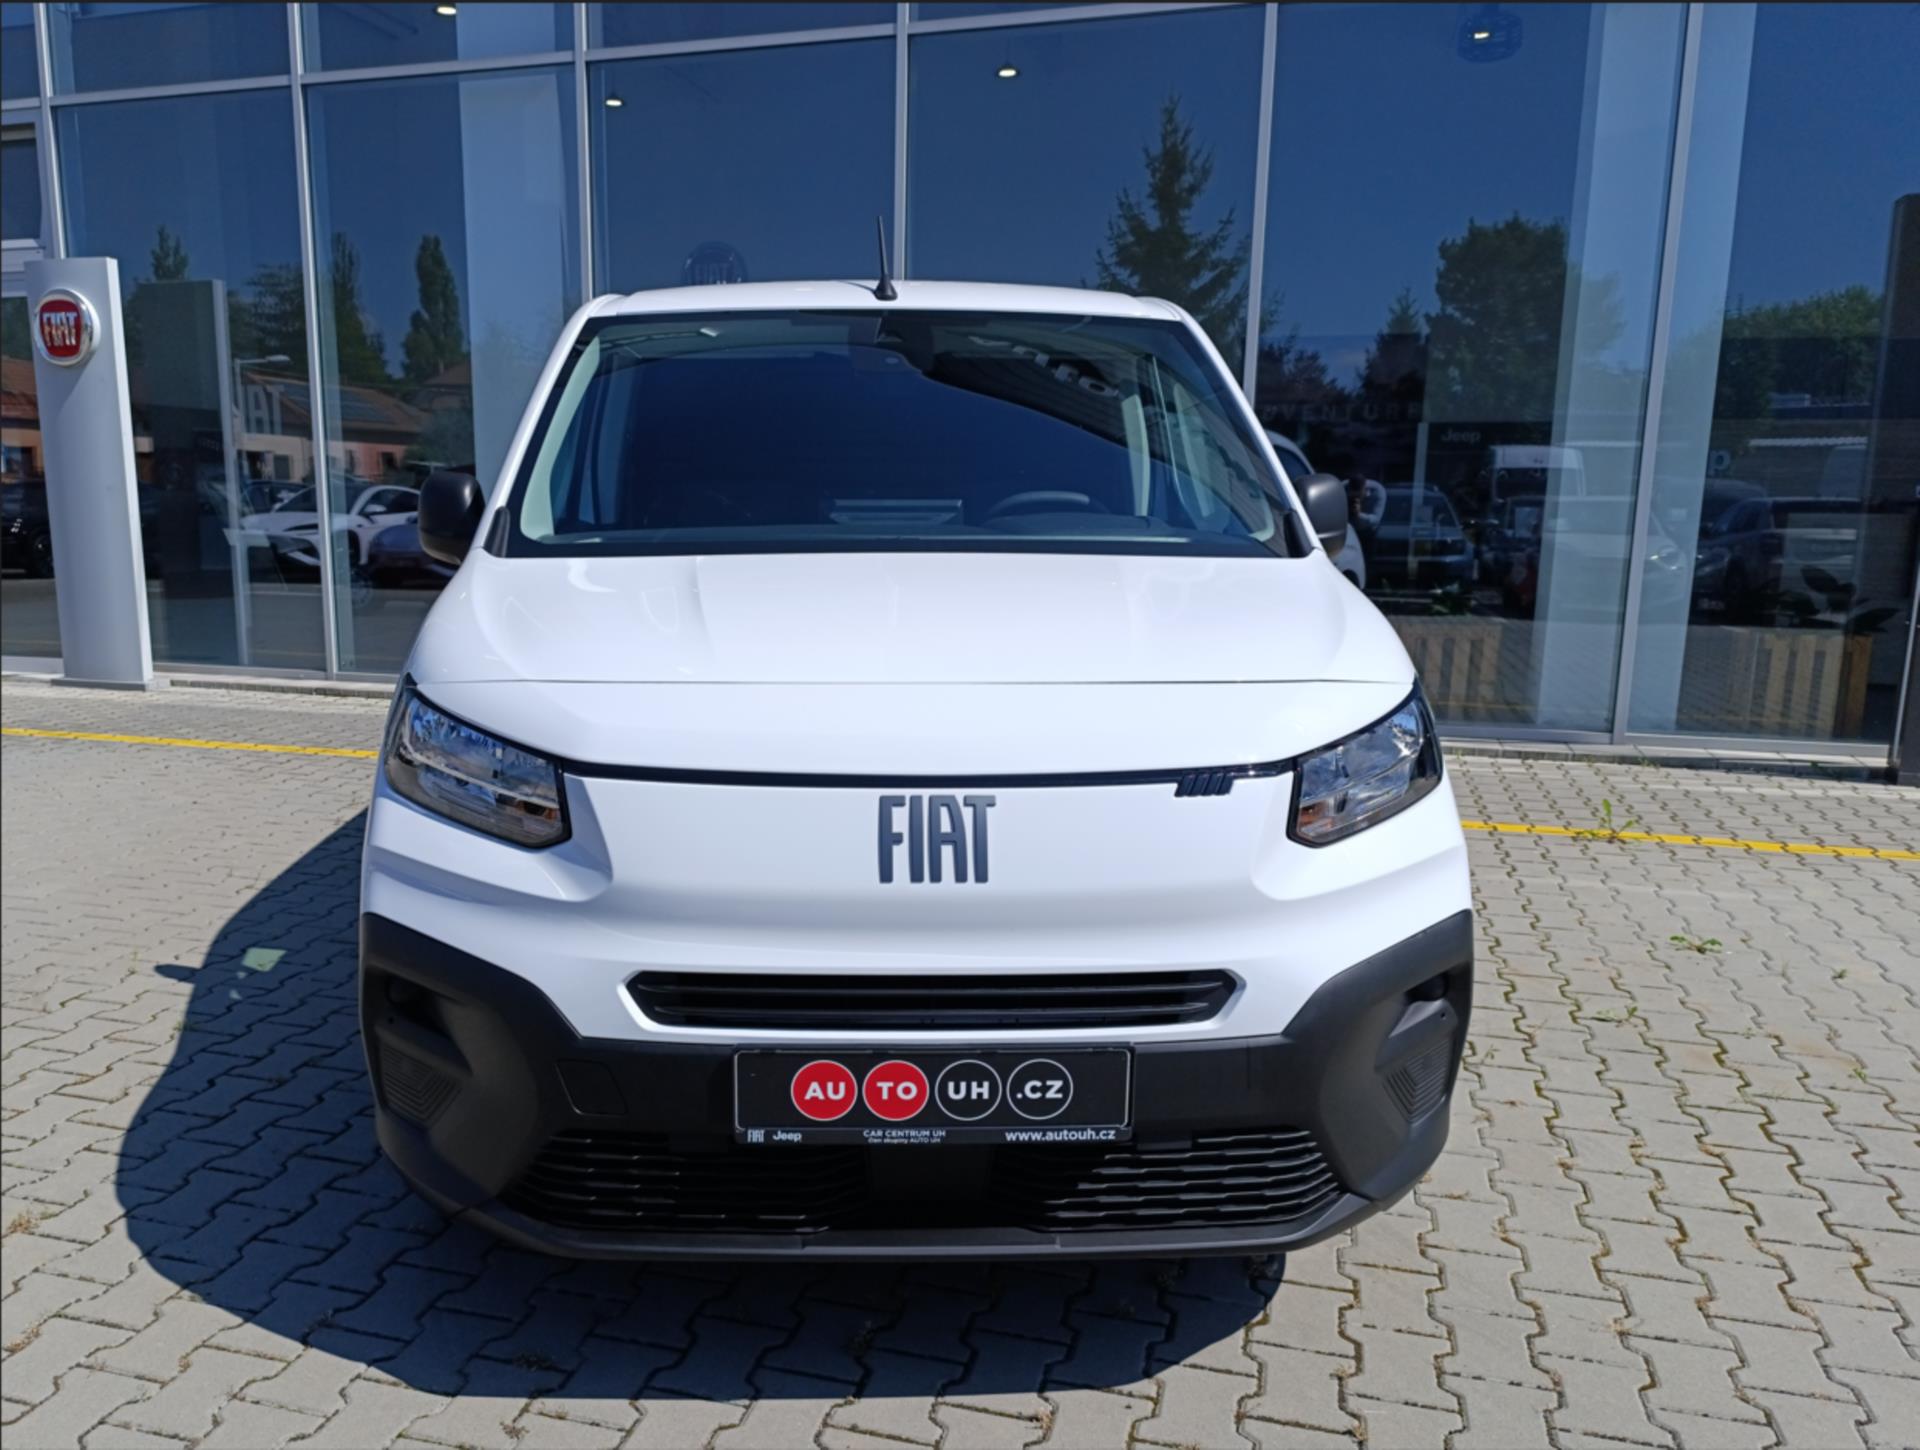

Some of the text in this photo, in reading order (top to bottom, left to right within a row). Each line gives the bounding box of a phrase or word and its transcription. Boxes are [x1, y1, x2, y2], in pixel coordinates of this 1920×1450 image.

[42, 312, 78, 346] FIAT
[1441, 428, 1481, 443] Jeep
[878, 794, 996, 884] FIAT
[804, 1080, 1063, 1100] AU TO UH .CZ
[773, 1129, 803, 1143] Jeep
[863, 1129, 946, 1138] CAR CENTRUM UH
[1005, 1127, 1116, 1142] www.autouh.cz
